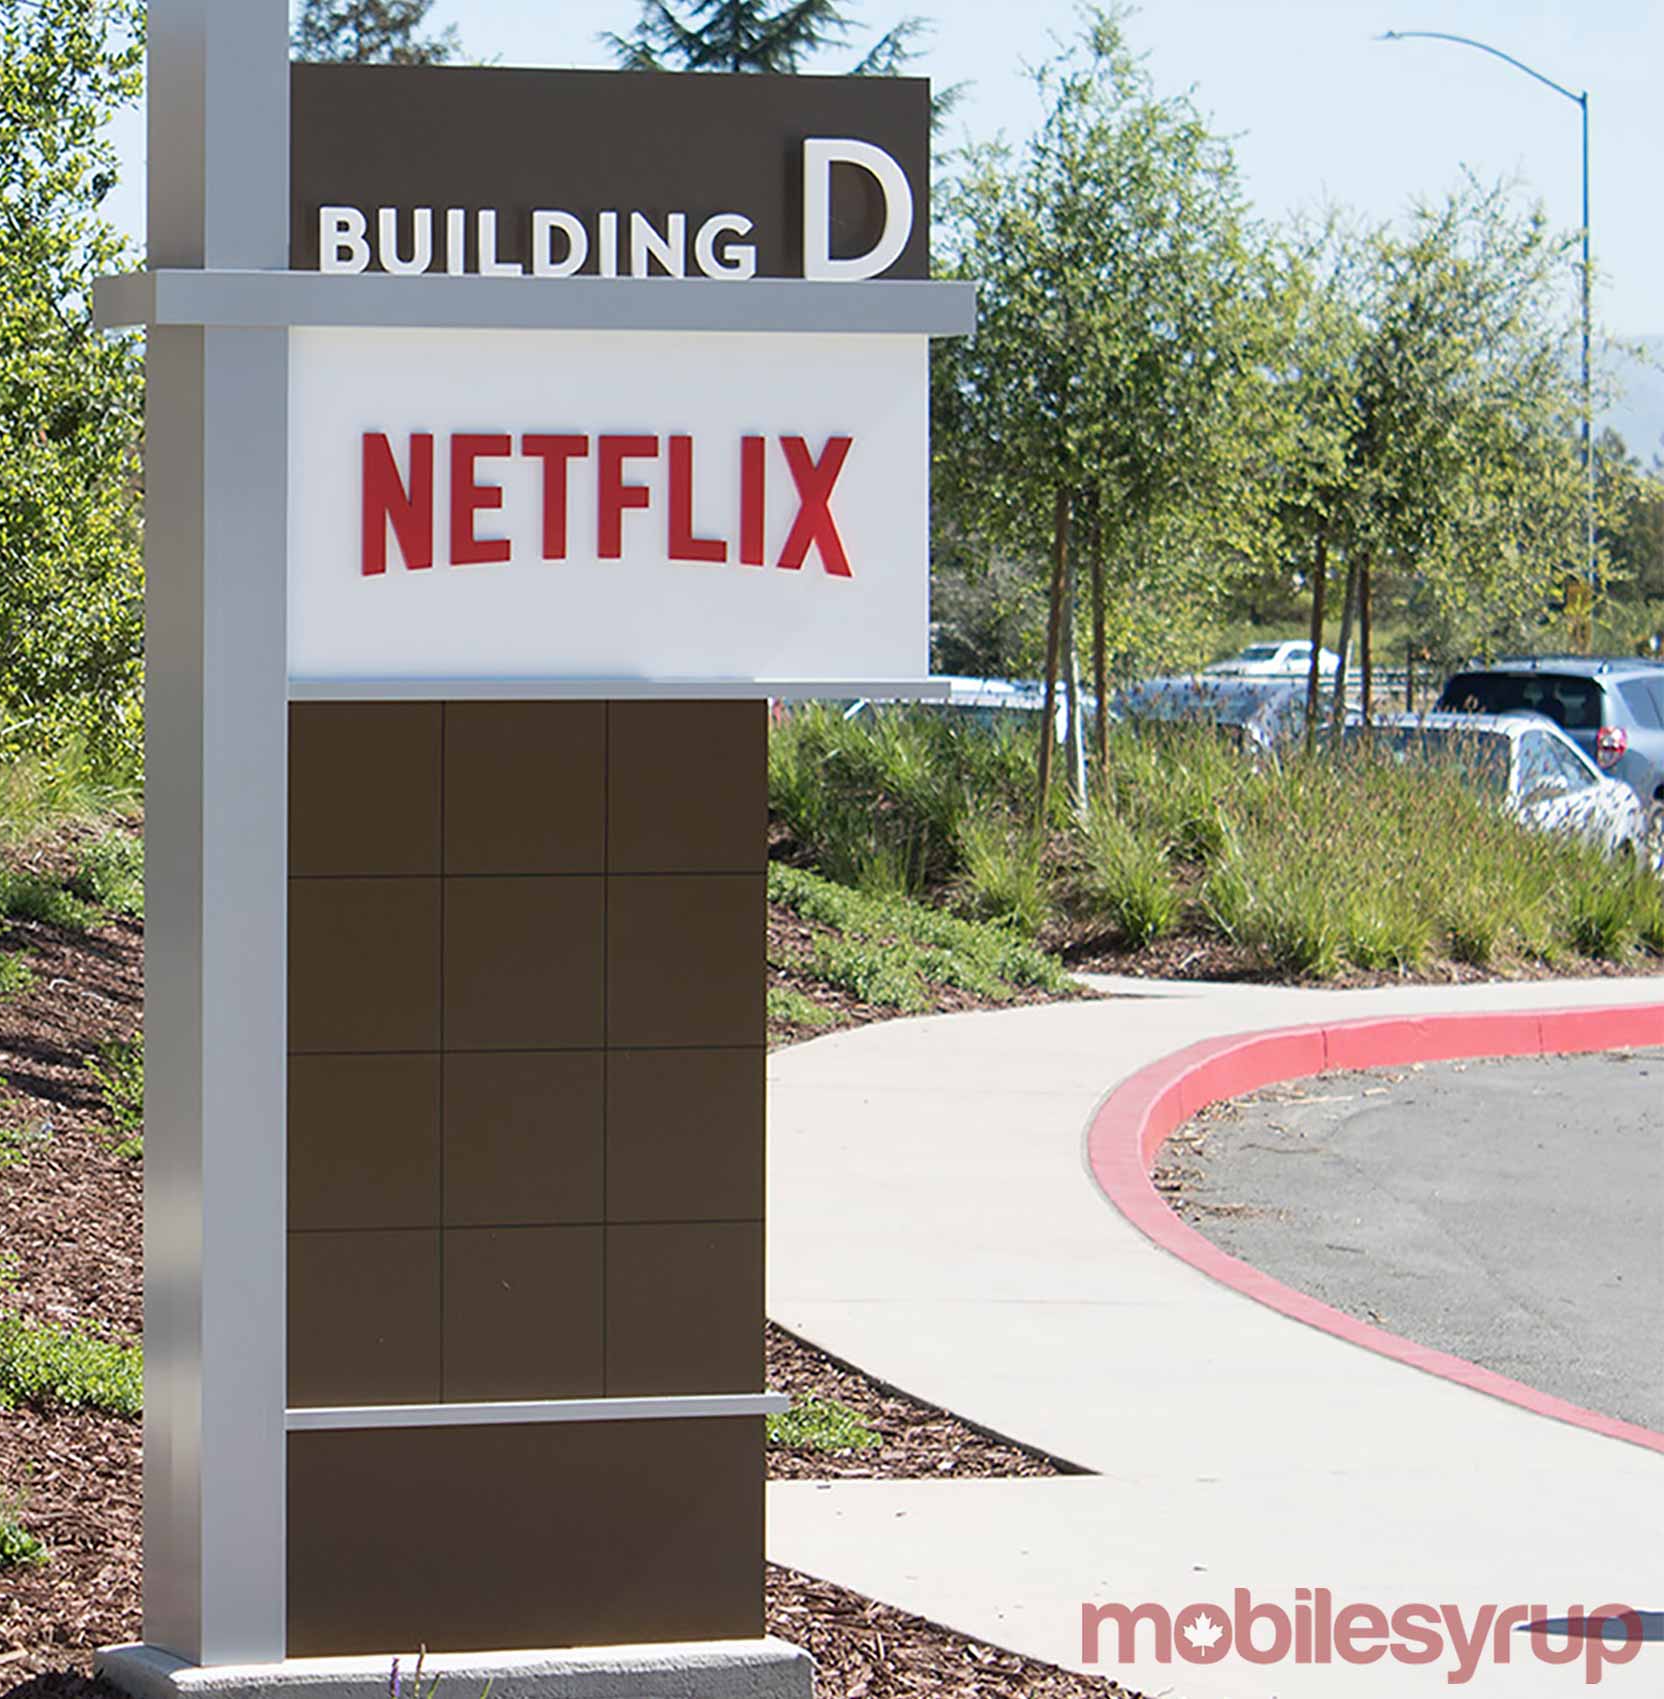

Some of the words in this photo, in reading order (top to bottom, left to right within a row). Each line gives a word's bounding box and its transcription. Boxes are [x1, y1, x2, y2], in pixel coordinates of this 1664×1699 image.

[318, 206, 757, 281] BUILDING
[803, 138, 914, 282] D
[361, 432, 853, 578] NETFLIX
